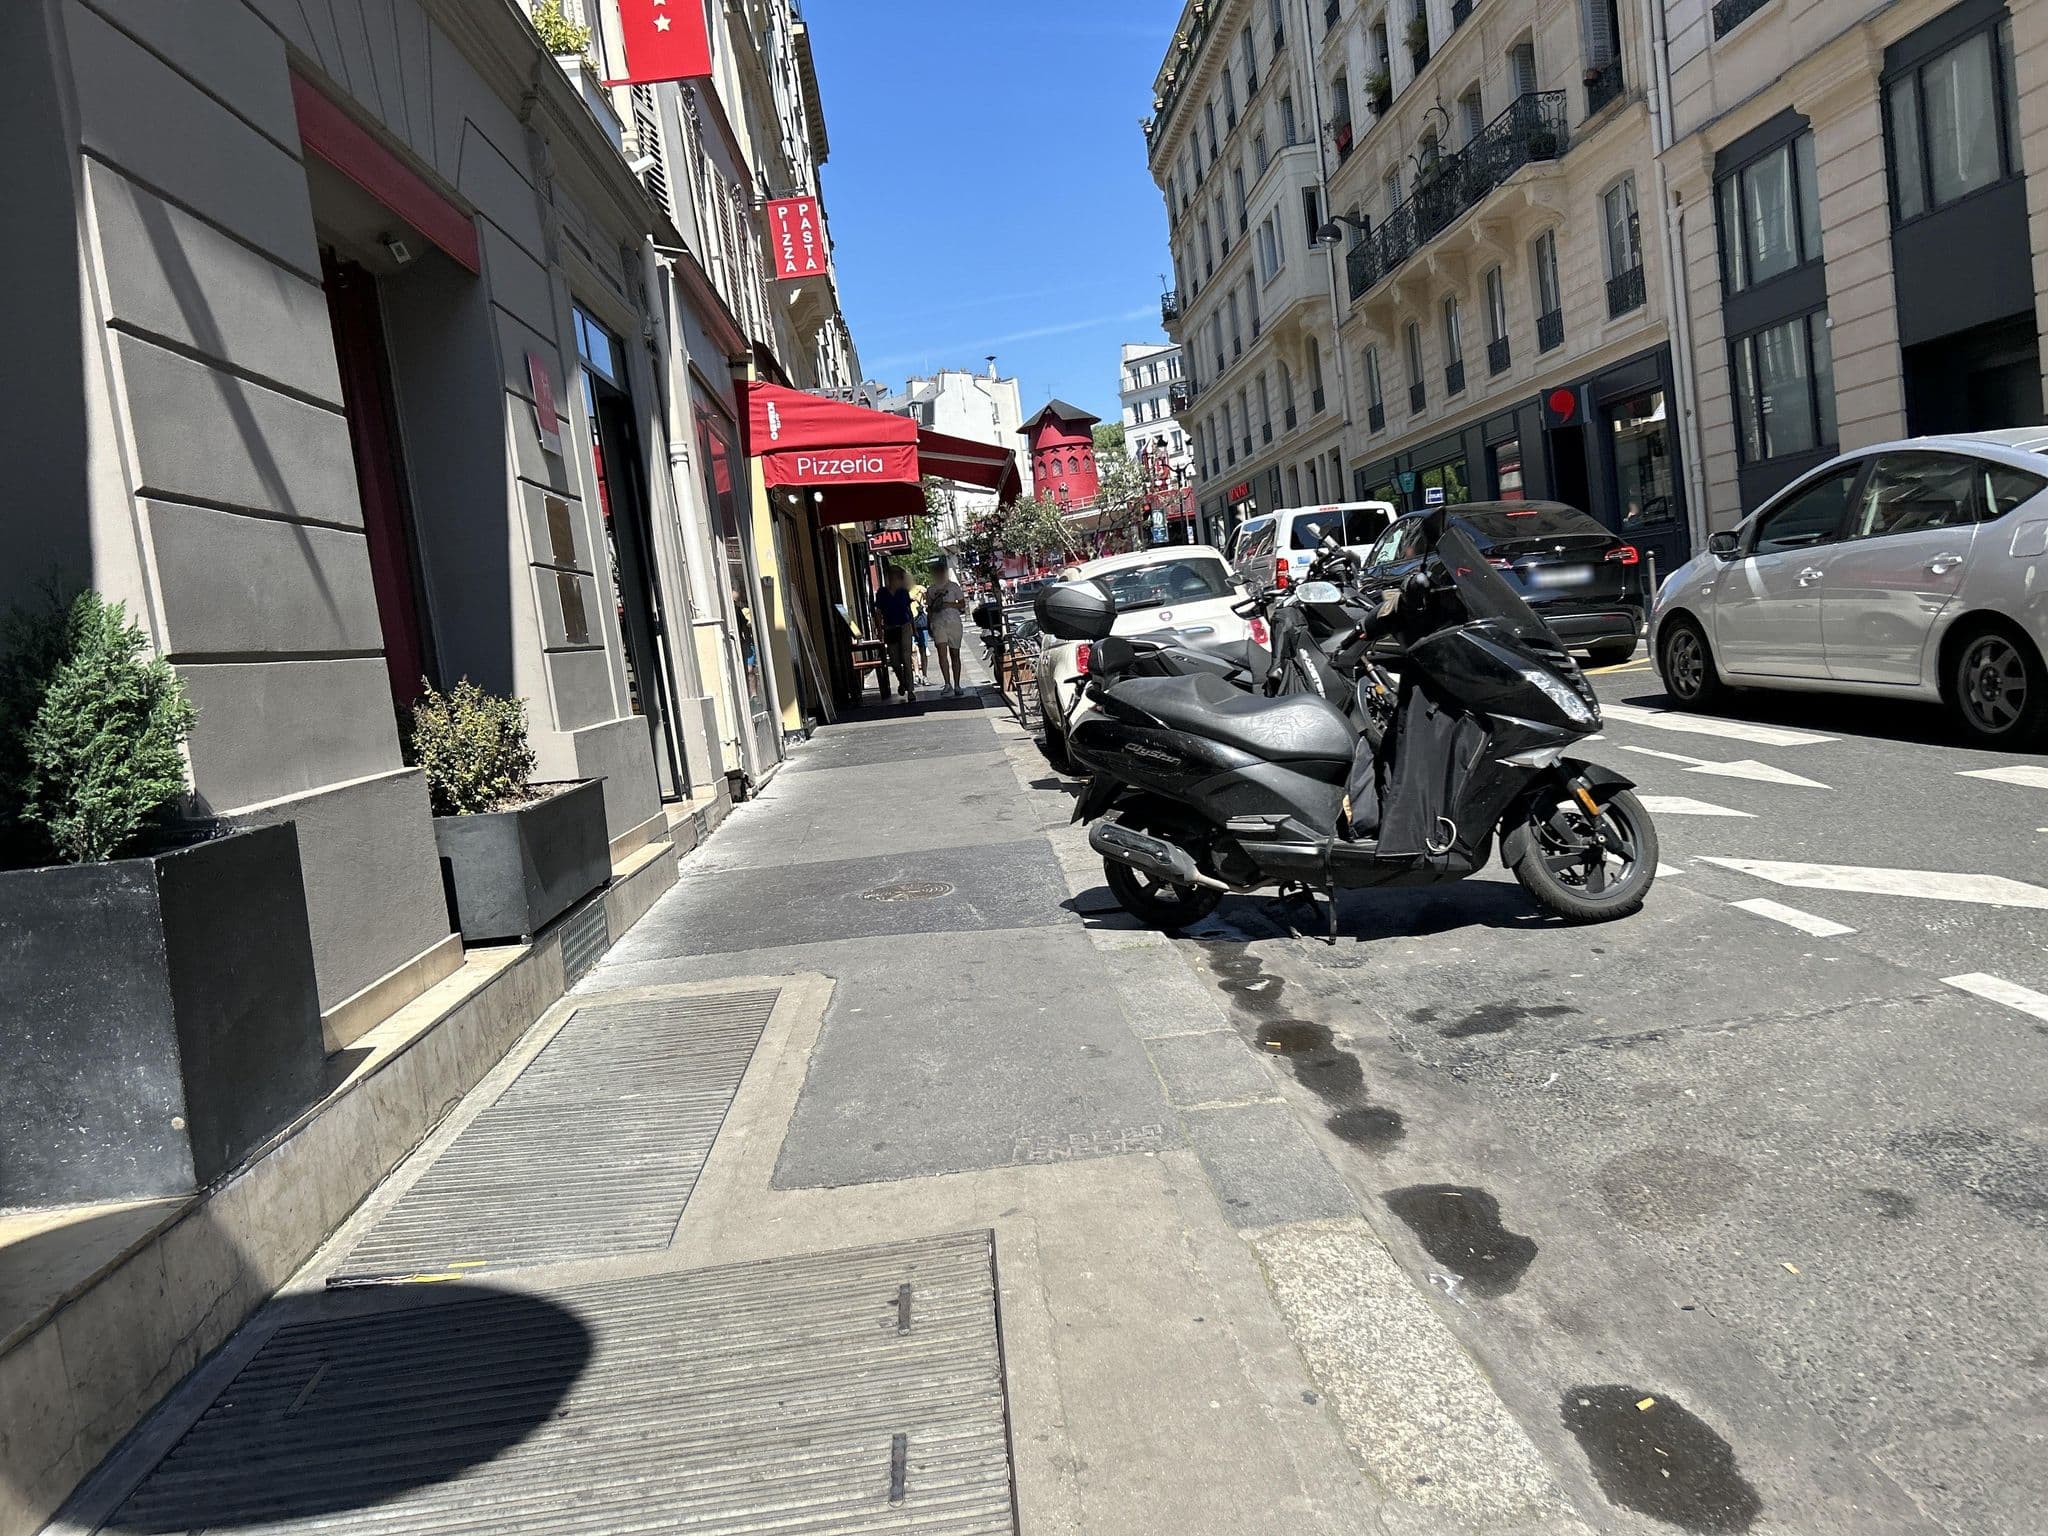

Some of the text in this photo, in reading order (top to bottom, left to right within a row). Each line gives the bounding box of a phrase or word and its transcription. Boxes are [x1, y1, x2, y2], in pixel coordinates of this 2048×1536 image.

[777, 206, 797, 273] PIZZA
[798, 203, 817, 270] PASTA
[797, 454, 883, 476] Pizzeria
